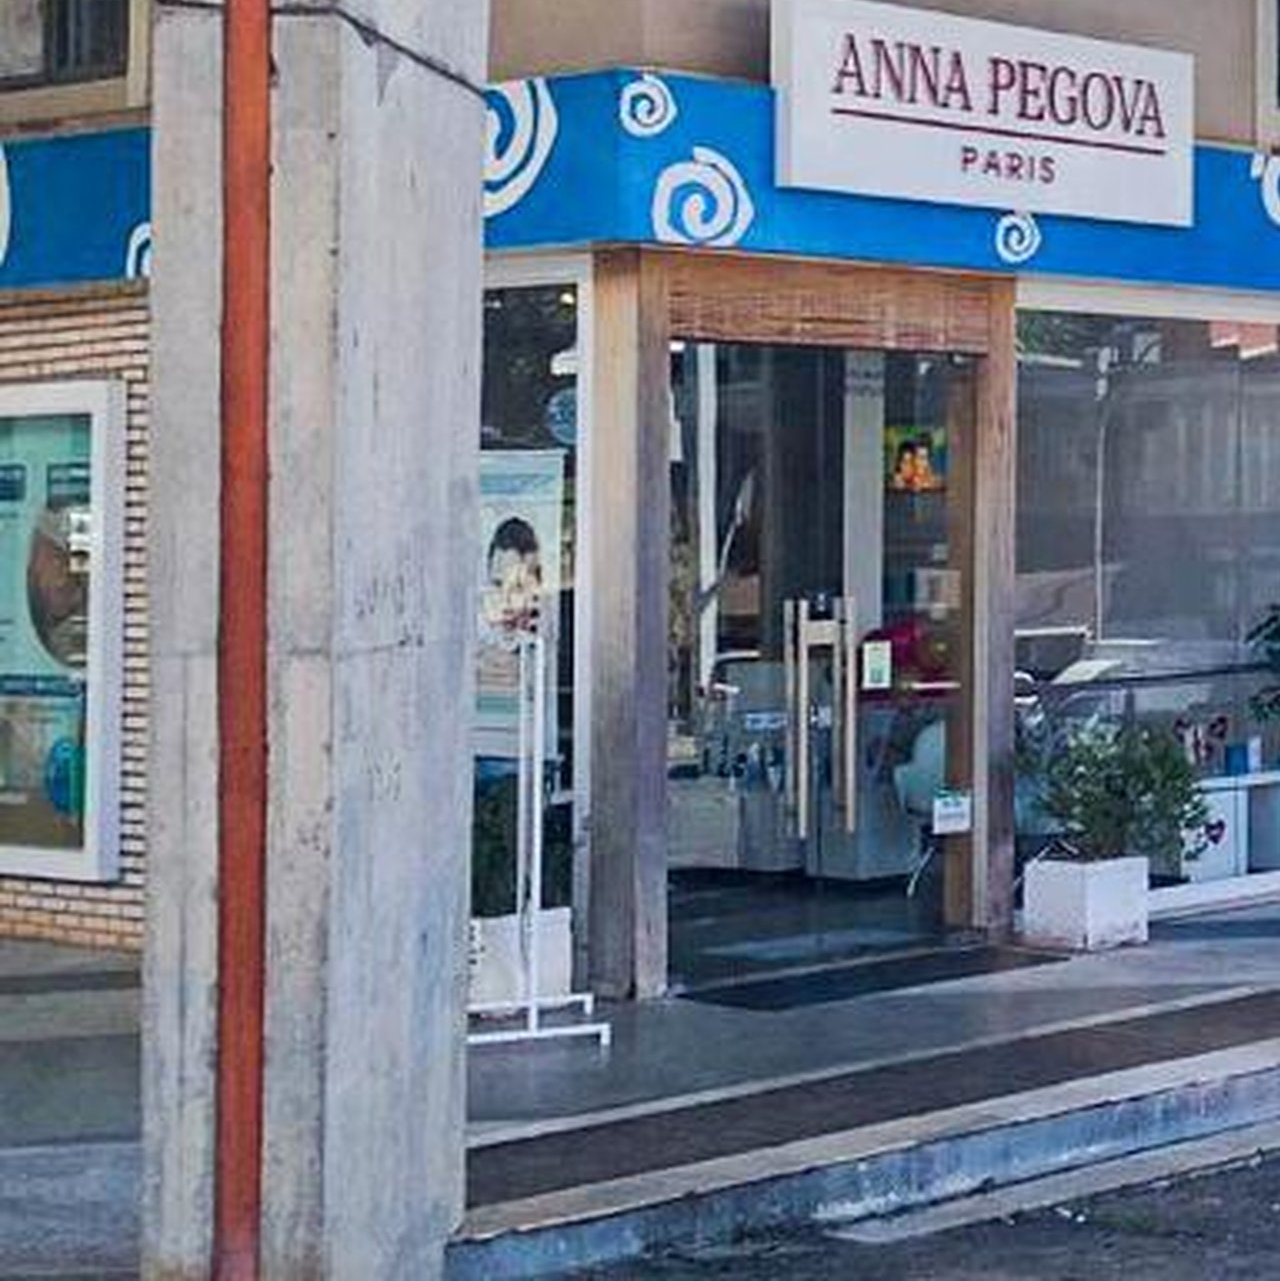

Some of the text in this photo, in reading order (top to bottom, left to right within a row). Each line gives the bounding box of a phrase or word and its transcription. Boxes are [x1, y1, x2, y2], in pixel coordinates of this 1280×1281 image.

[832, 33, 1166, 138] ANNA PEGOVA
[961, 146, 1056, 184] PARIS
